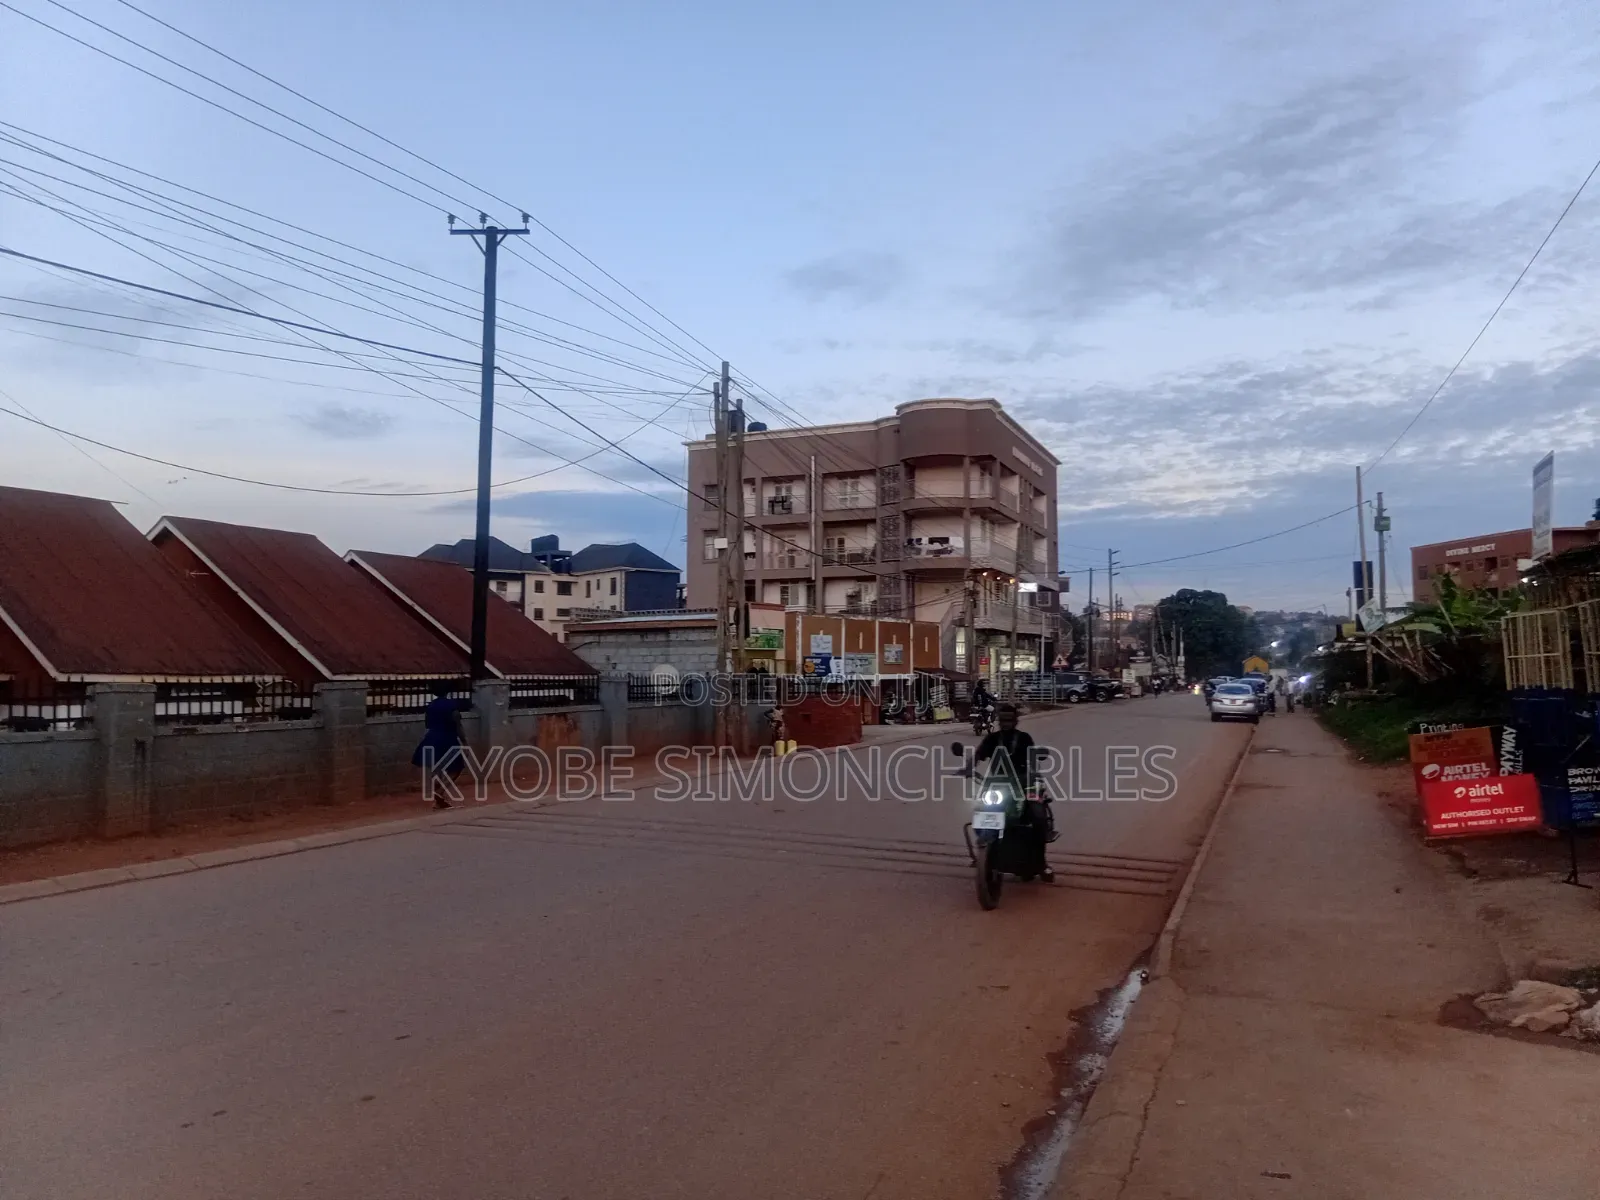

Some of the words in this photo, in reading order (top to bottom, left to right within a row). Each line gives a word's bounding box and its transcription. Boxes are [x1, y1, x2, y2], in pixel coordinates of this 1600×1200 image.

[1500, 725, 1519, 777] PAYWAY
[1443, 762, 1490, 776] AIRTEL
[1441, 771, 1490, 782] MONEY
[1469, 783, 1504, 797] airtel
[1441, 809, 1491, 819] AUTHORISED
[1492, 806, 1524, 815] OUTLET
